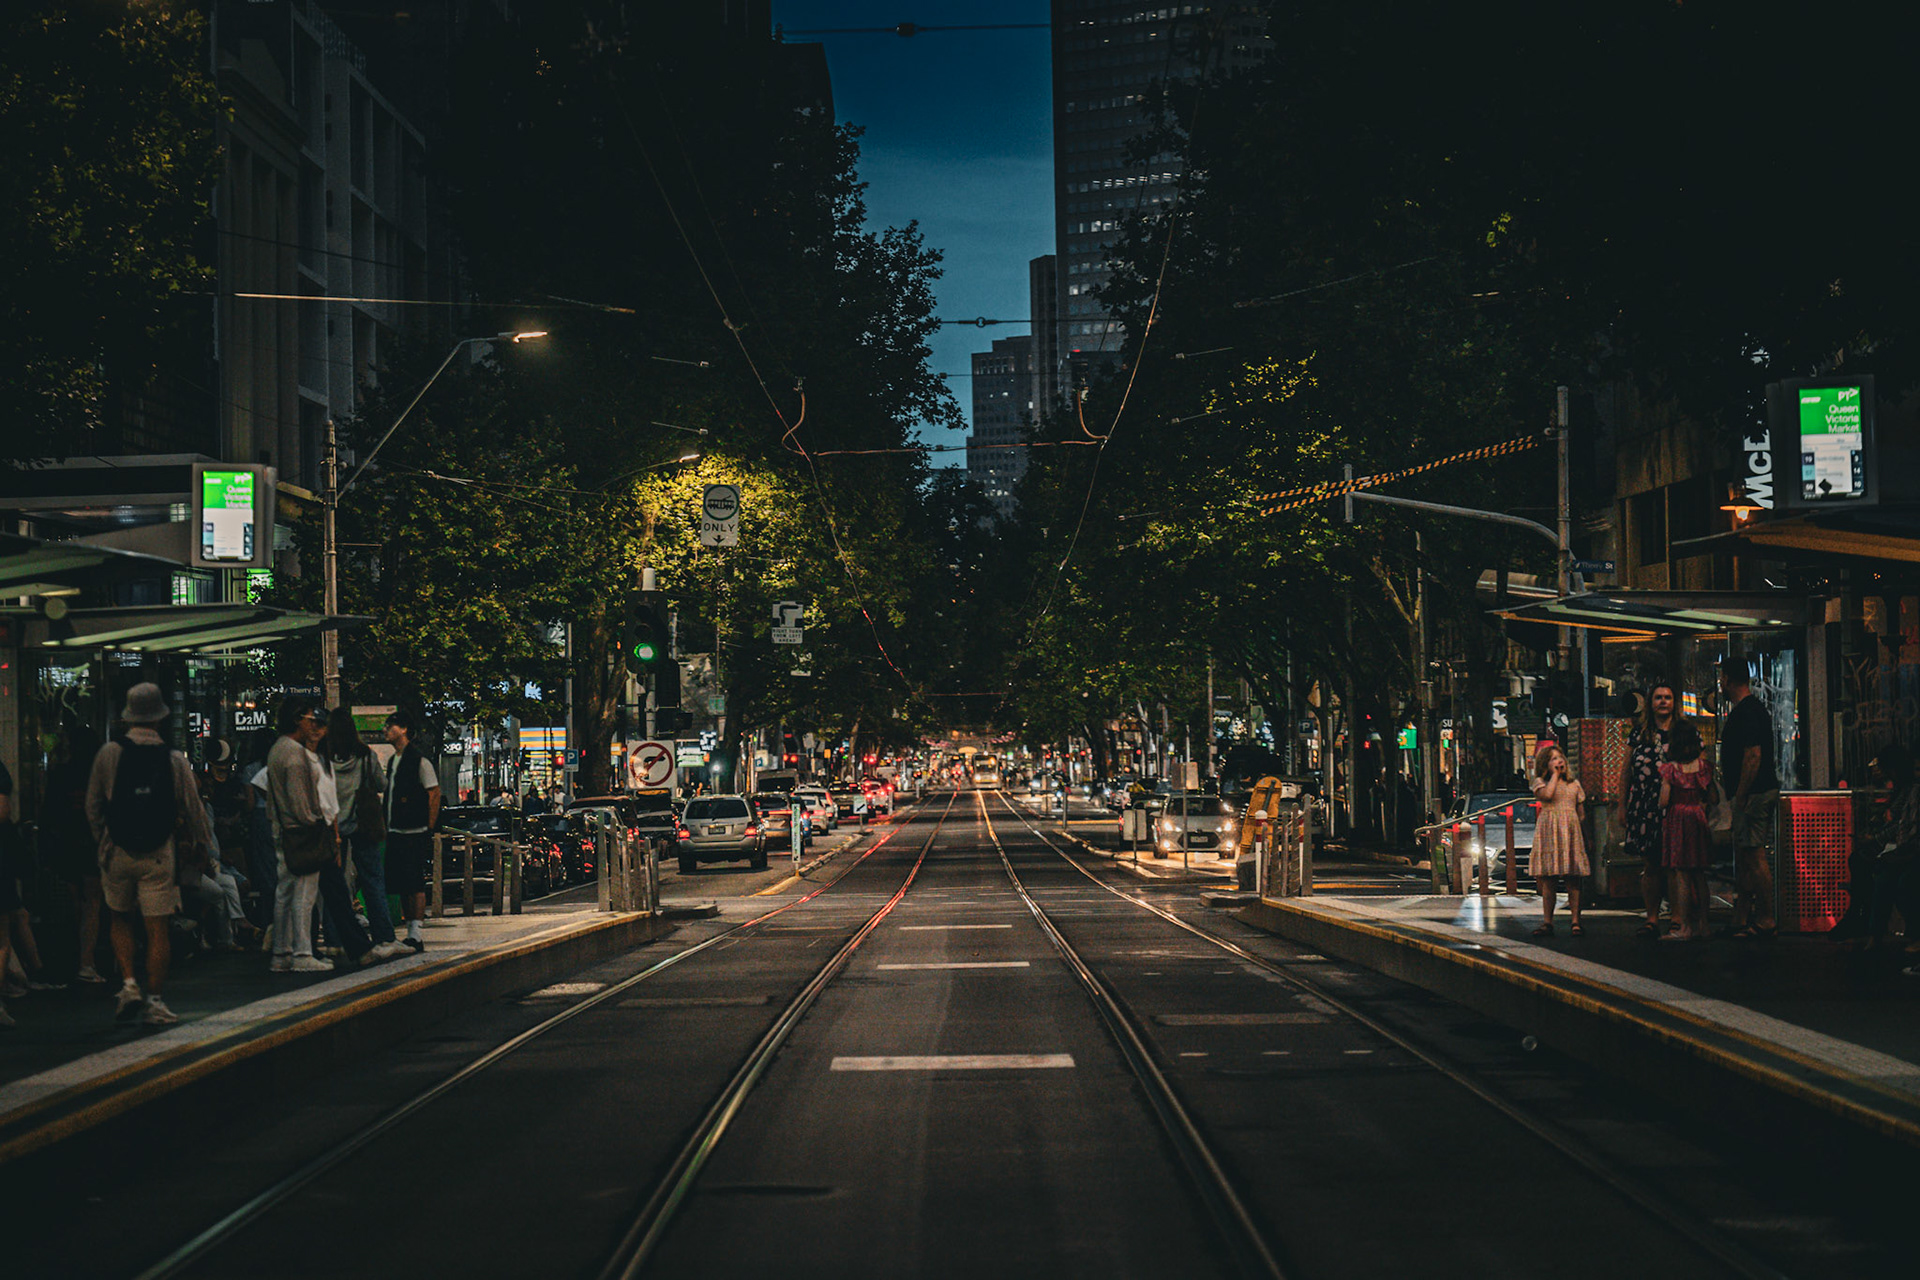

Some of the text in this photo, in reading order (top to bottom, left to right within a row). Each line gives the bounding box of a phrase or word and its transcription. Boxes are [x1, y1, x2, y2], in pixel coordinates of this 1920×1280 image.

[1829, 404, 1859, 414] Queen
[1825, 414, 1860, 424] Victoria
[1828, 424, 1860, 434] Market
[703, 522, 736, 532] ONLY
[289, 686, 321, 695] Therry St
[234, 711, 267, 725] D2M
[567, 752, 576, 763] P
